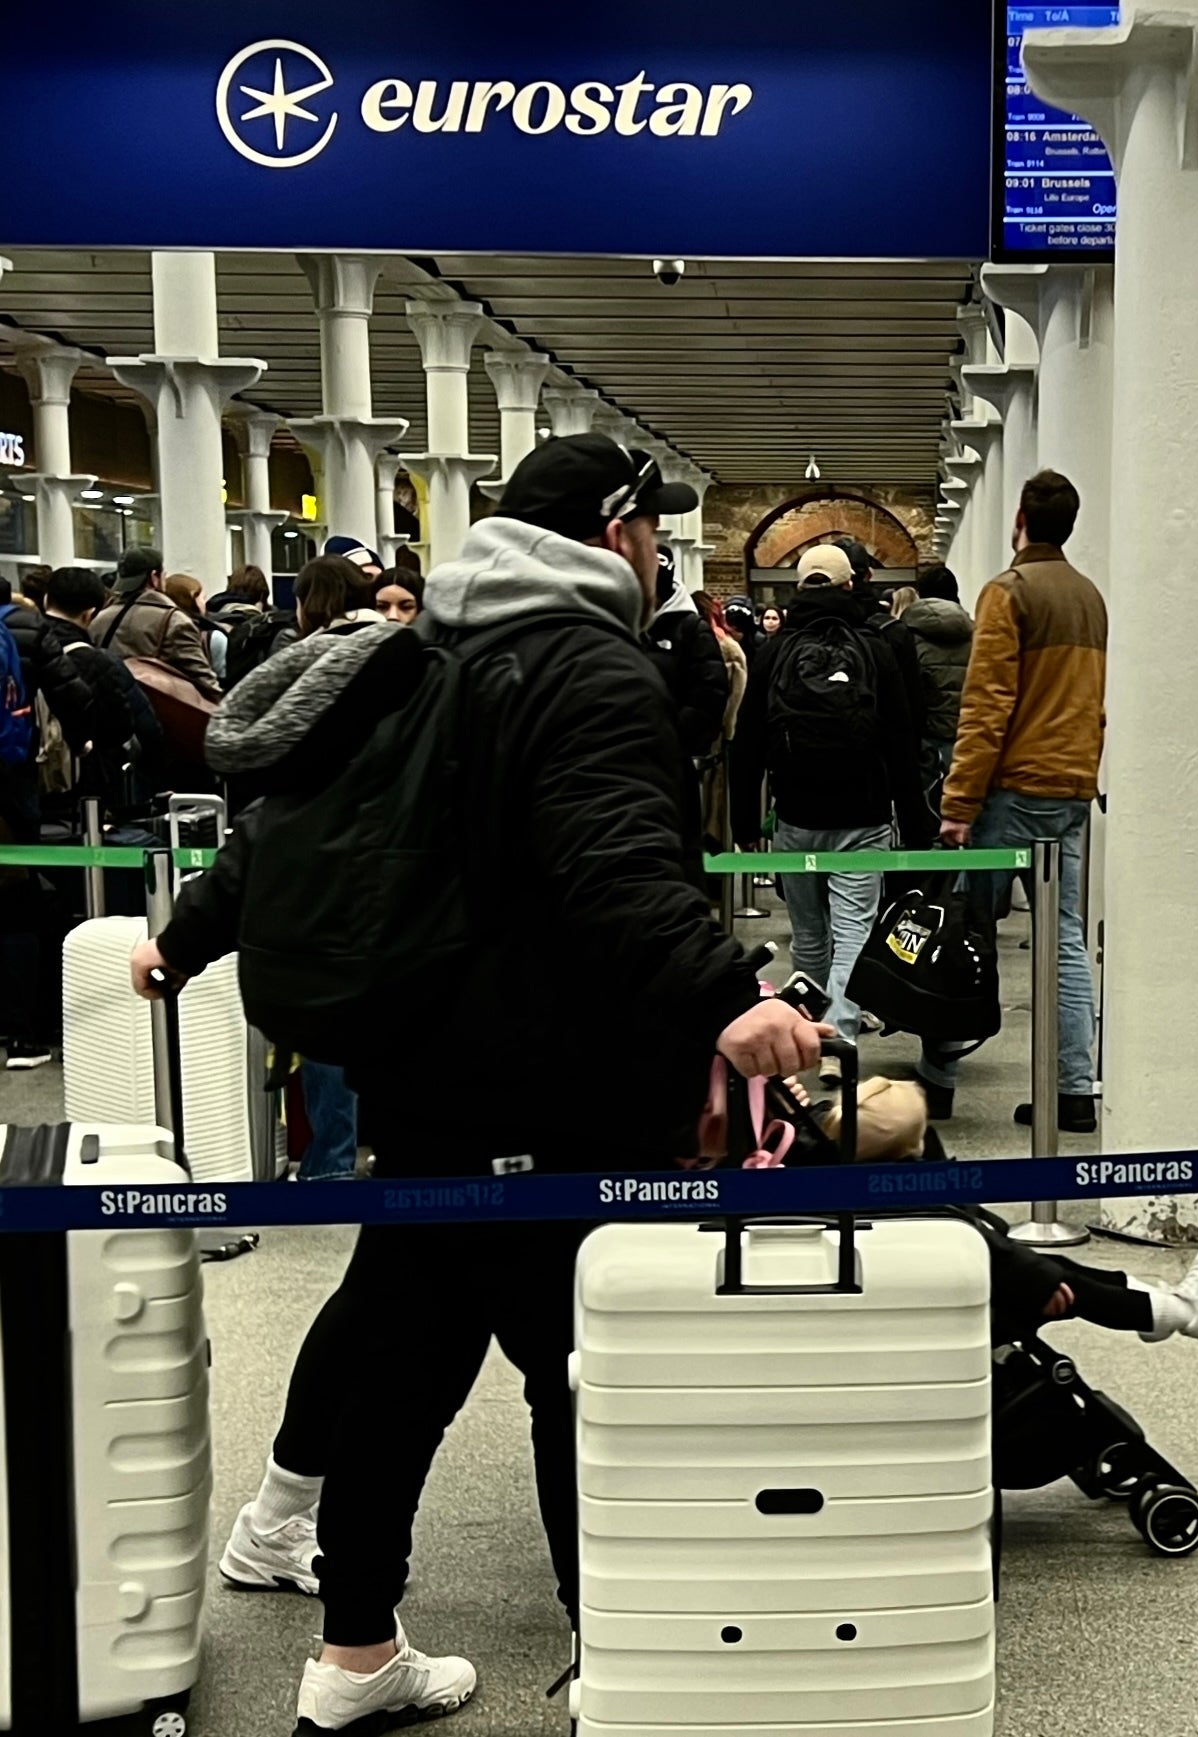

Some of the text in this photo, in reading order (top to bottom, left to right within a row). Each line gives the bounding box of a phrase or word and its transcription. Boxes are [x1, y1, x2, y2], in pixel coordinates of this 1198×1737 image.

[1007, 84, 1031, 95] 08:0
[361, 71, 753, 137] eurostar
[1041, 178, 1091, 188] Brussels
